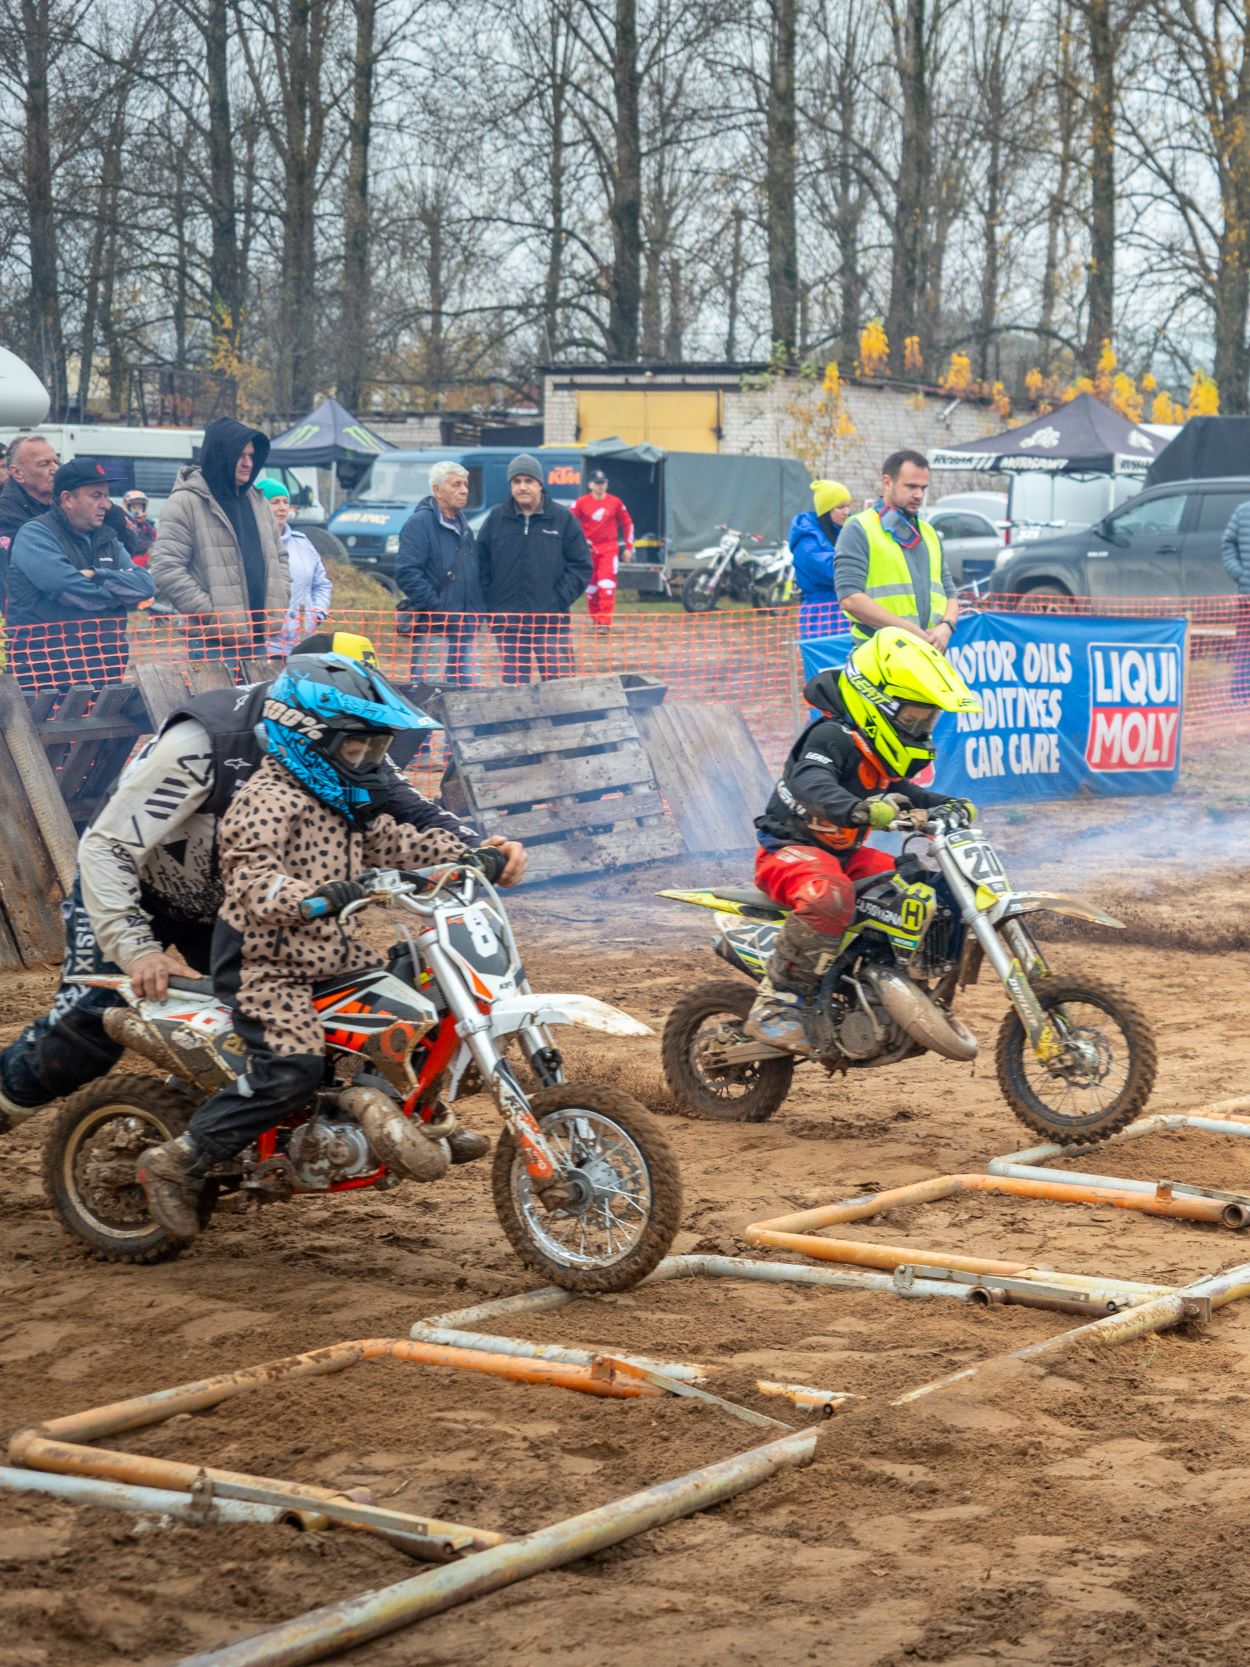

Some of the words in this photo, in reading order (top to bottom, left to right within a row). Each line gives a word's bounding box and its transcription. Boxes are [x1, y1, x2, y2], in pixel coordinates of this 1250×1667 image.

[1023, 642, 1073, 684] OILS
[1094, 650, 1177, 706] LIQUI
[263, 699, 329, 740] 100%
[1091, 711, 1178, 765] MOLY
[965, 735, 1006, 780] CAR
[1008, 733, 1061, 774] CARE
